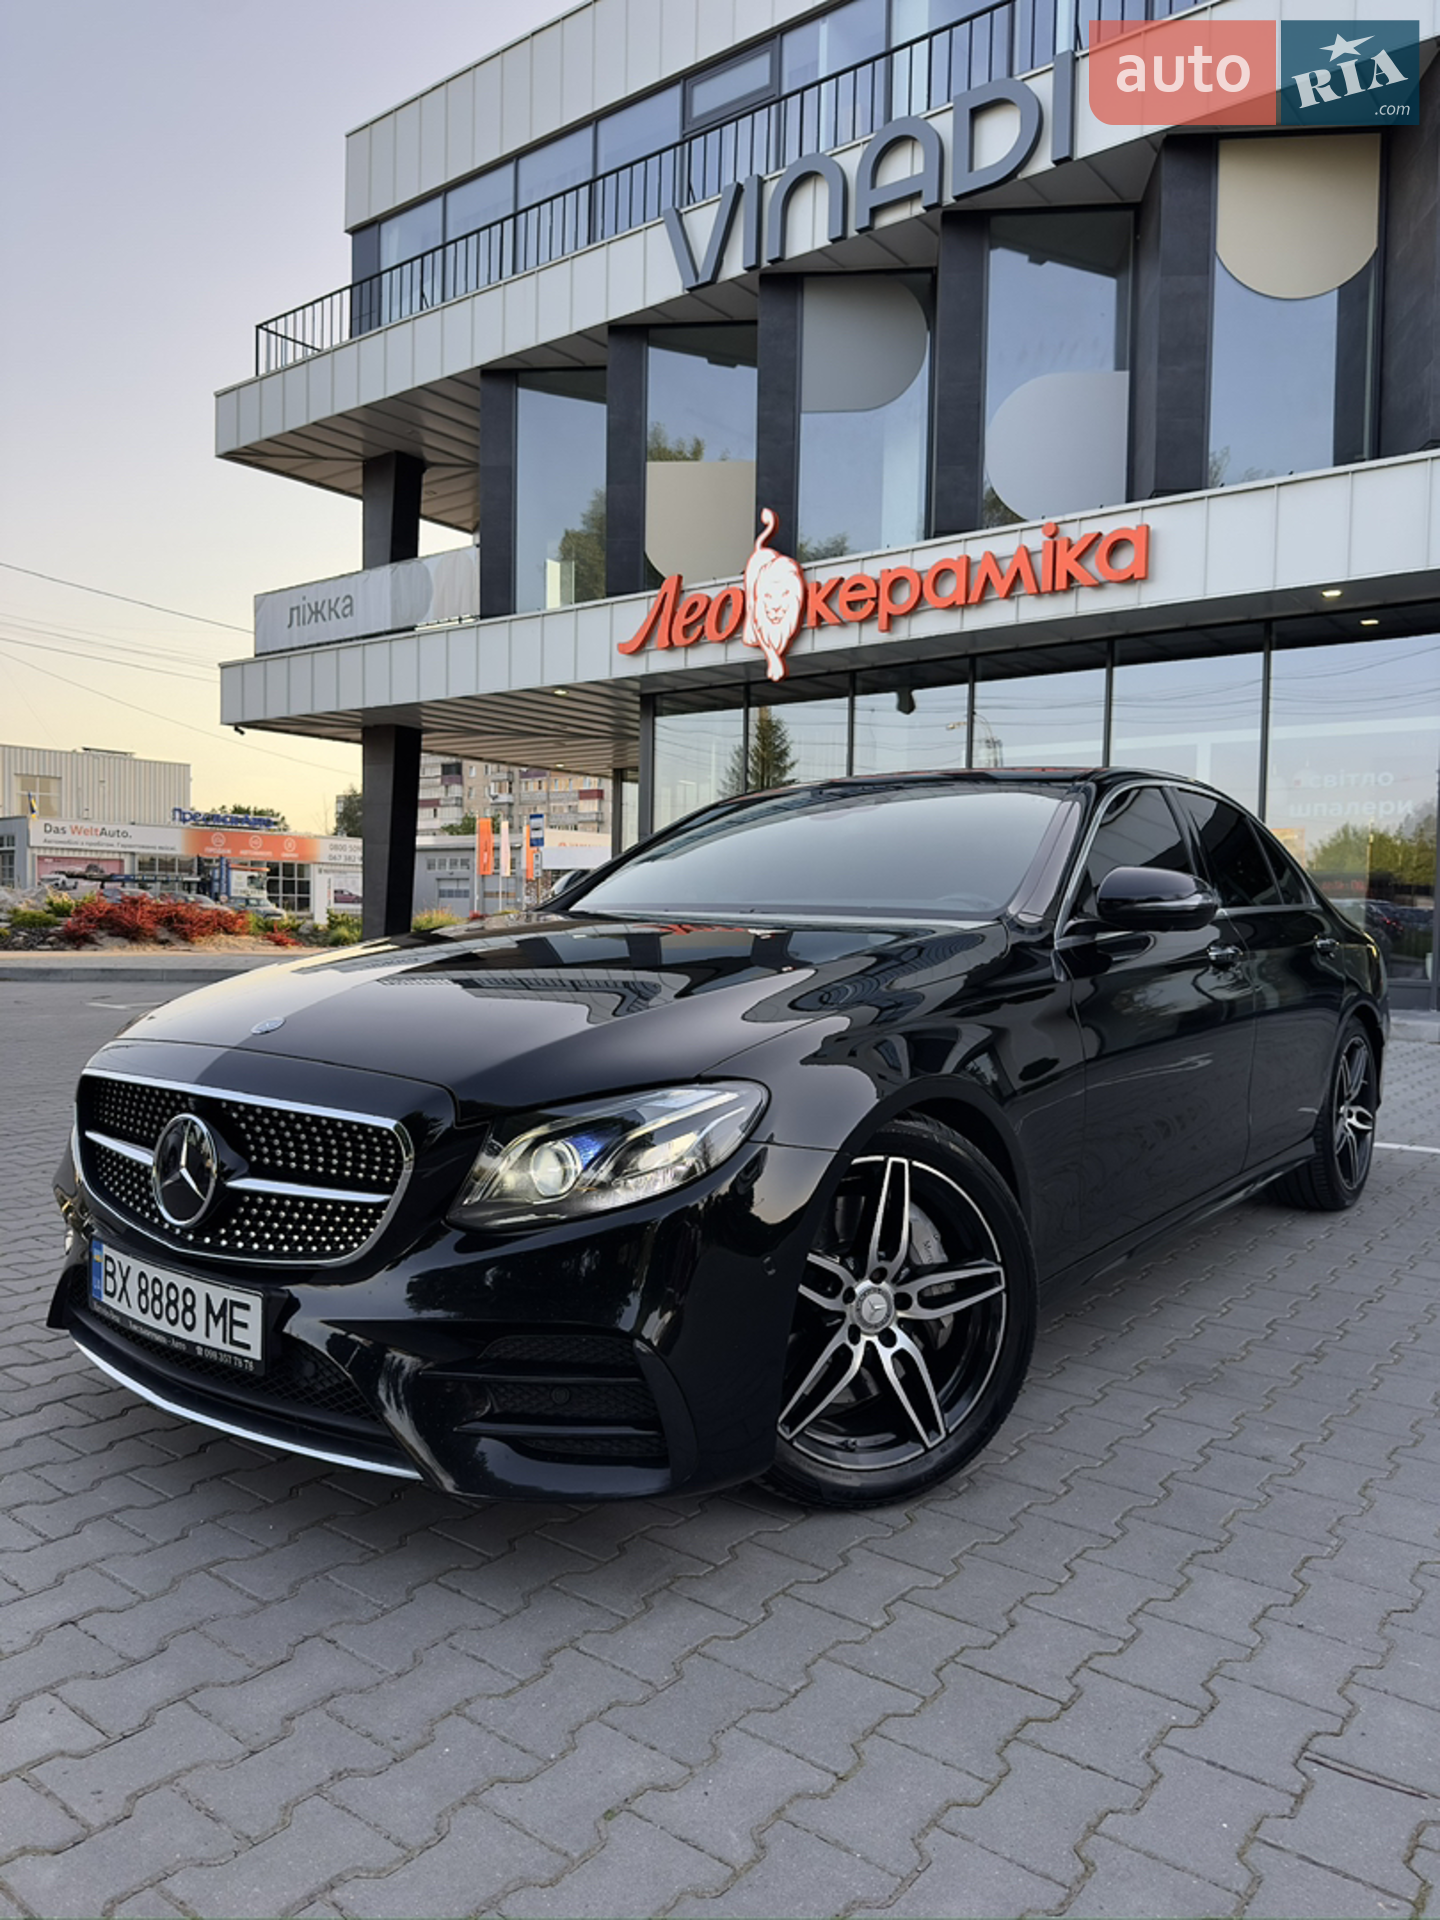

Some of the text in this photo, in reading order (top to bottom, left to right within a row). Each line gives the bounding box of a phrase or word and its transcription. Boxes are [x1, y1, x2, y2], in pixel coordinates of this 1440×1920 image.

[287, 593, 354, 630] ліжка
[1309, 768, 1395, 789] світло
[1289, 799, 1413, 819] шпалери
[43, 822, 132, 839] Das WeltAuto.
[103, 1254, 132, 1308] BX
[137, 1271, 196, 1332] 8888
[205, 1292, 251, 1350] ME
